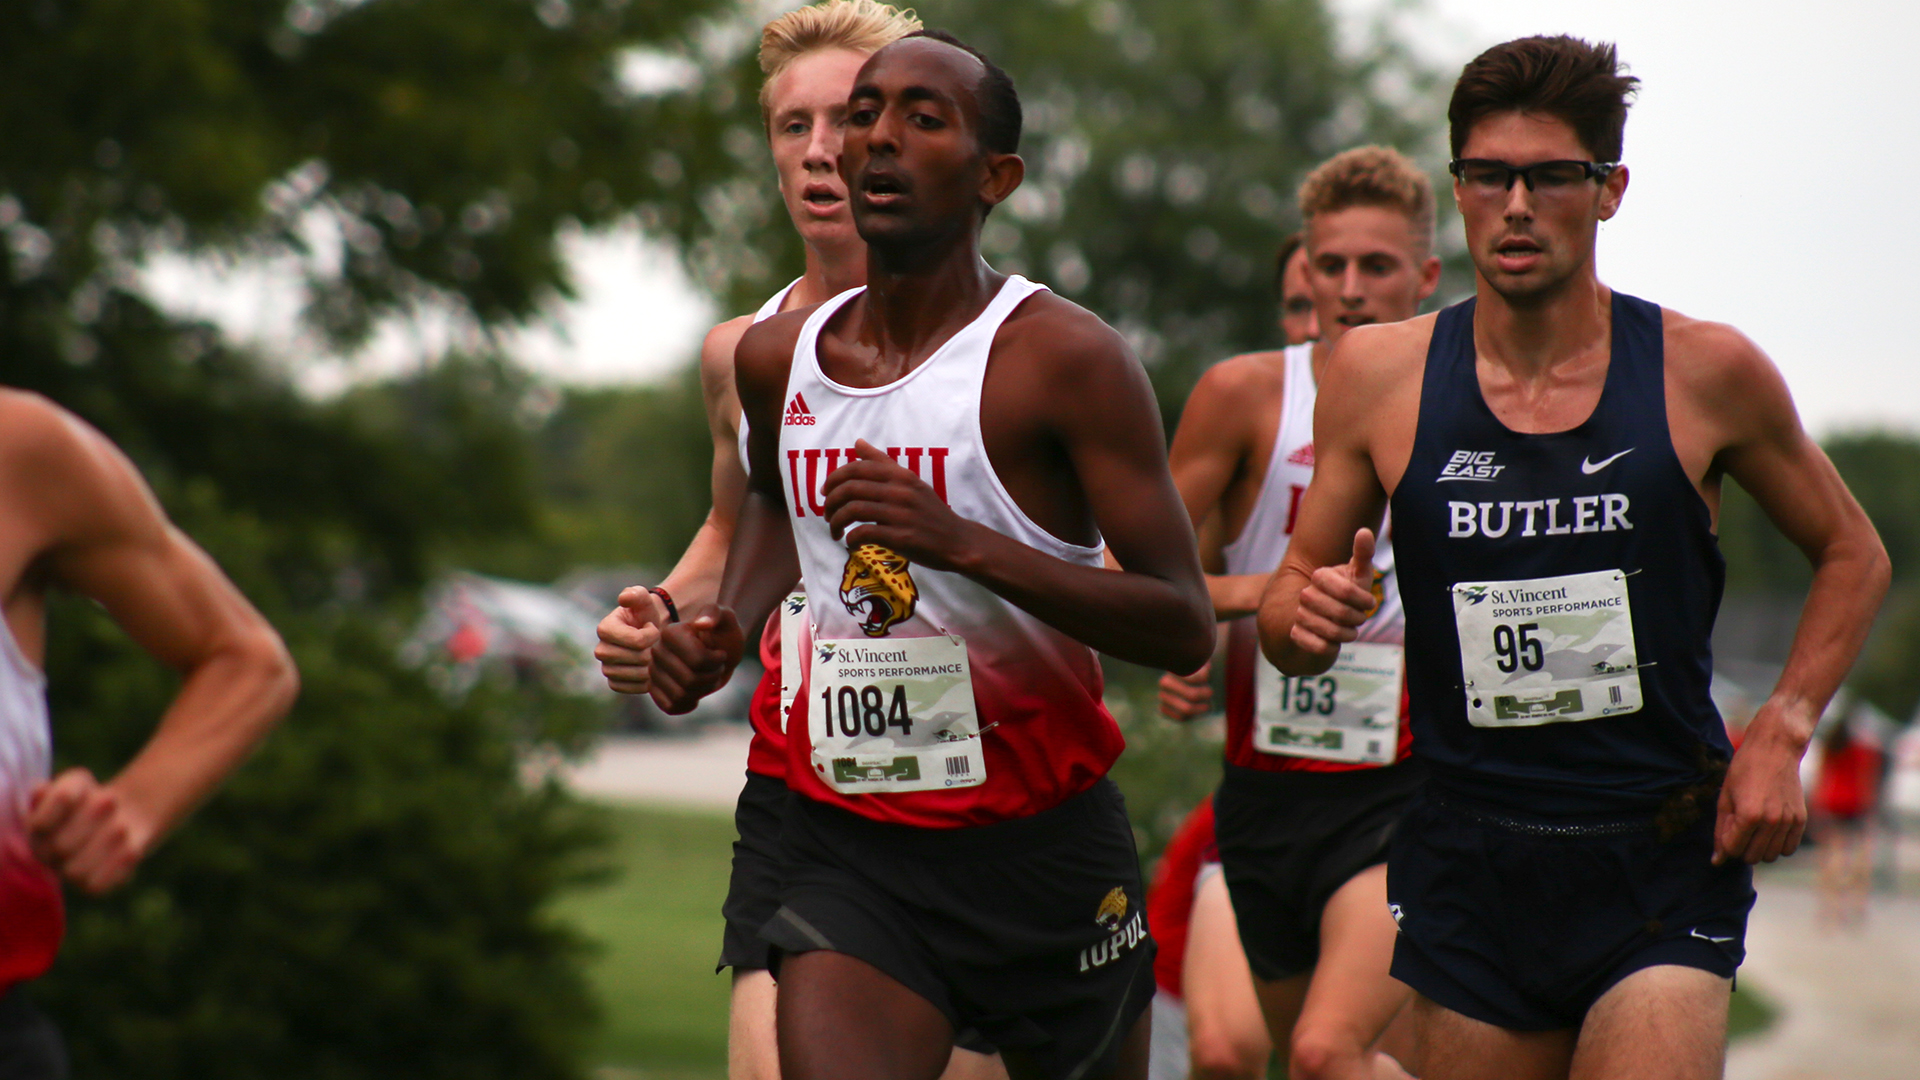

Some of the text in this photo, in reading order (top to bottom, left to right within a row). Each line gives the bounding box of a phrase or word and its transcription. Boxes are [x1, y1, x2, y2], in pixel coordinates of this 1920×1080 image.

[1441, 463, 1506, 478] EAST
[1449, 449, 1496, 465] BIG
[1448, 493, 1633, 538] BUTLER
[1493, 597, 1622, 617] SPORTS PERFORMANCE
[1493, 623, 1544, 673] 95
[838, 663, 962, 678] SPORTS PERFORMANCE
[1280, 675, 1337, 715] 153
[821, 684, 913, 738] 1084
